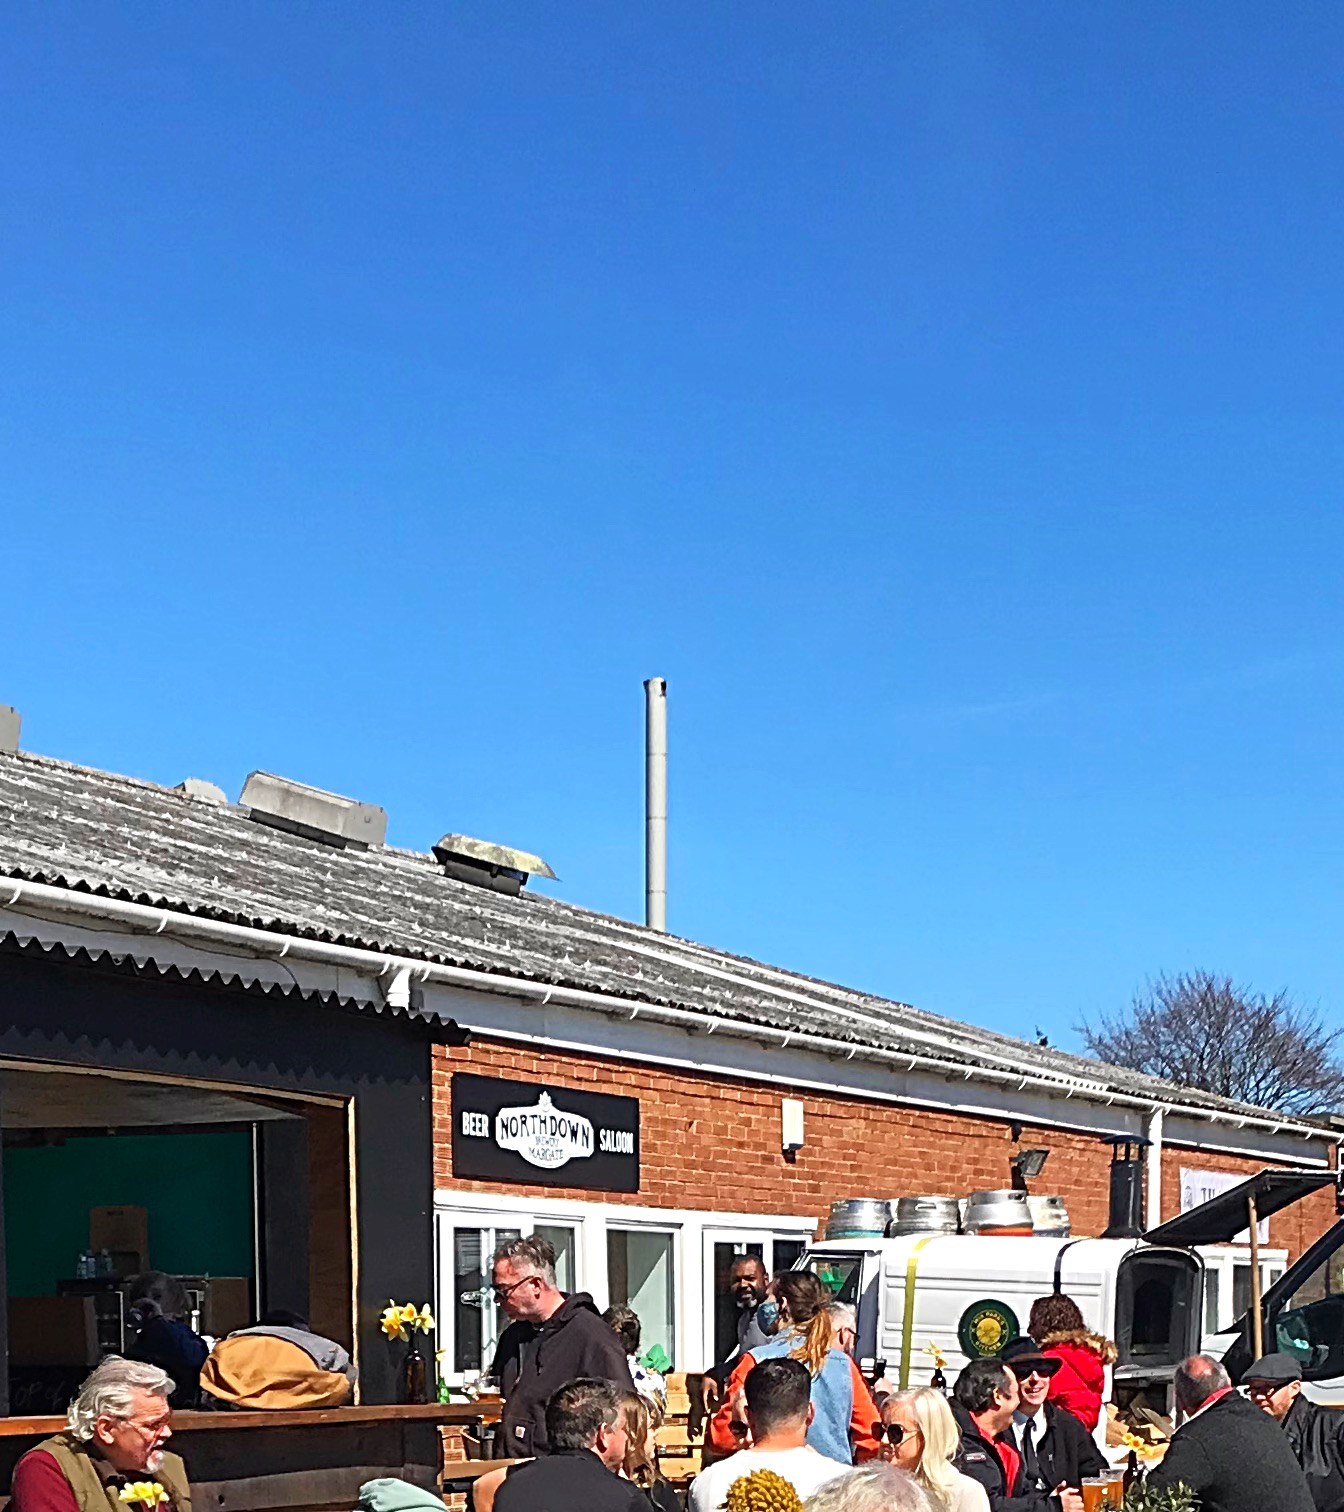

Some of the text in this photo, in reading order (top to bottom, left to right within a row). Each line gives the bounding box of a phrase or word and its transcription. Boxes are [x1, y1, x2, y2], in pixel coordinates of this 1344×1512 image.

[462, 1111, 489, 1138] BEER
[501, 1114, 591, 1149] NORTHDOWN
[529, 1147, 564, 1161] MARGATE
[599, 1129, 634, 1154] SALOON
